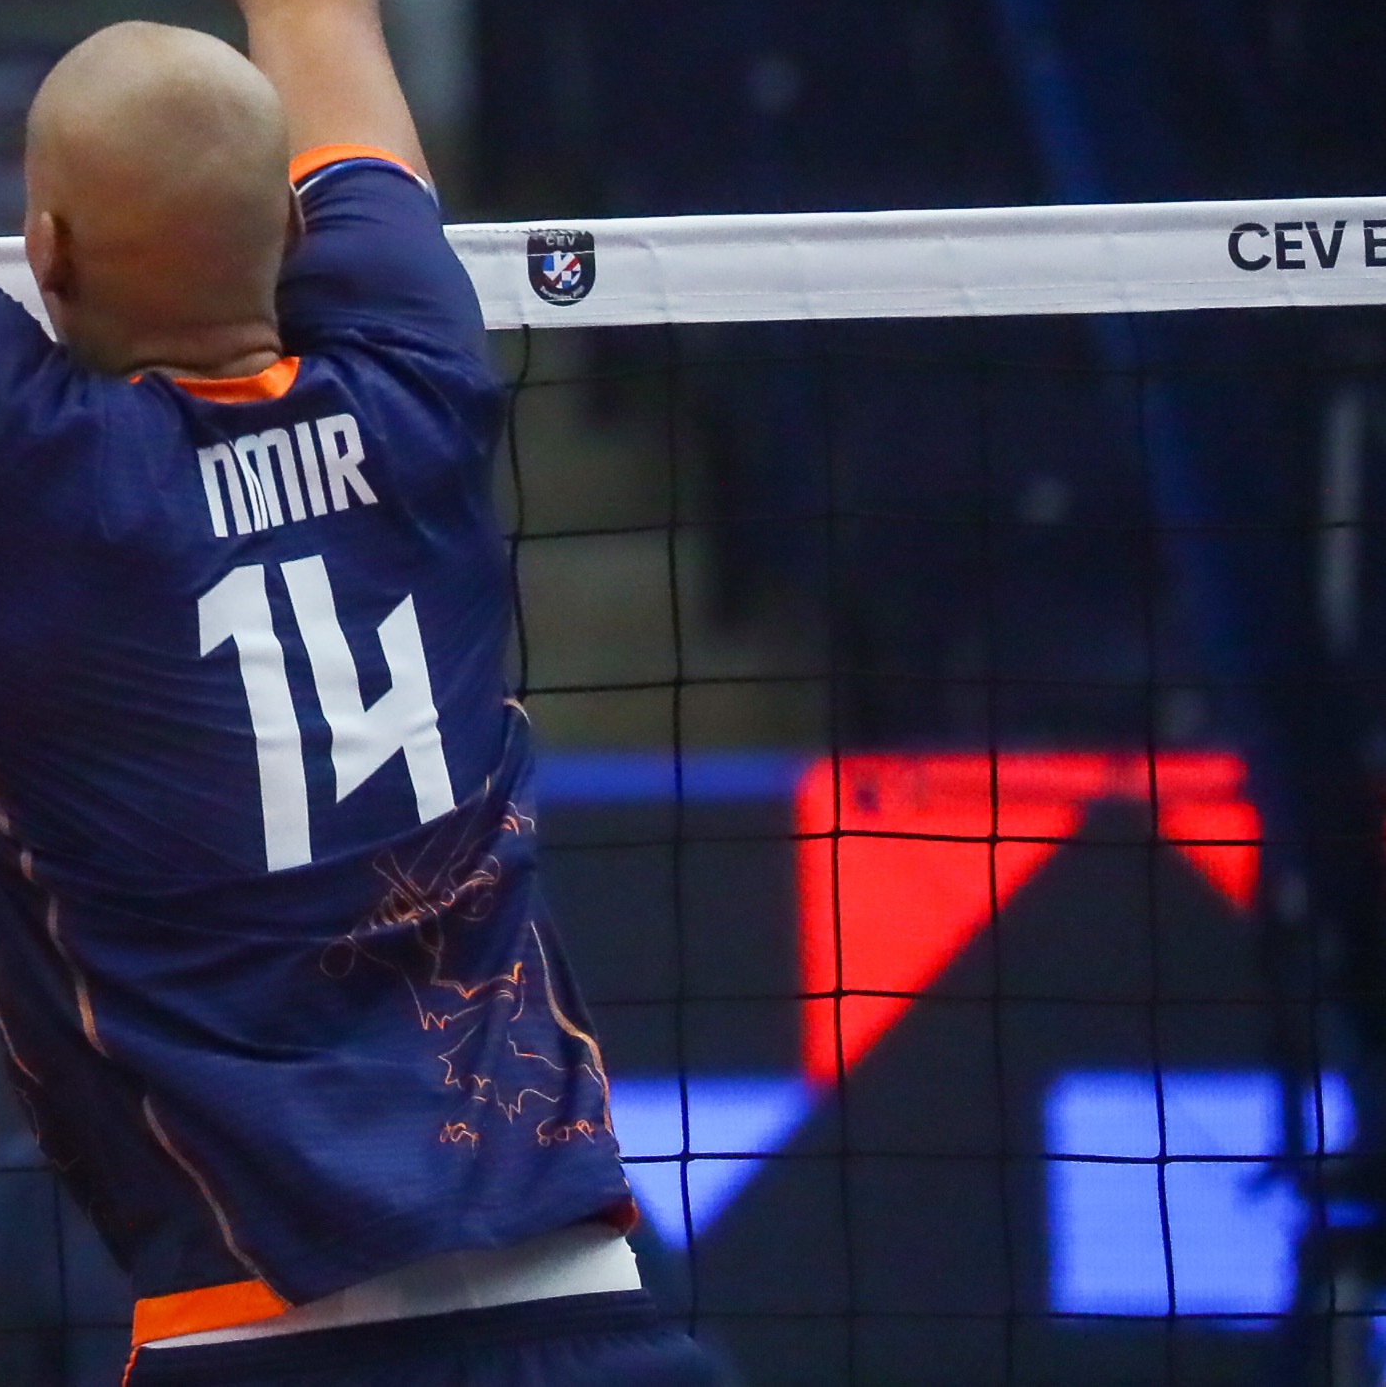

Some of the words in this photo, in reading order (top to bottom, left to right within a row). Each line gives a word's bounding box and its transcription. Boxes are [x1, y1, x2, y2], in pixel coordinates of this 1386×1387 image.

[545, 235, 576, 247] CEV
[1228, 220, 1347, 271] CEV
[197, 555, 455, 872] 14
